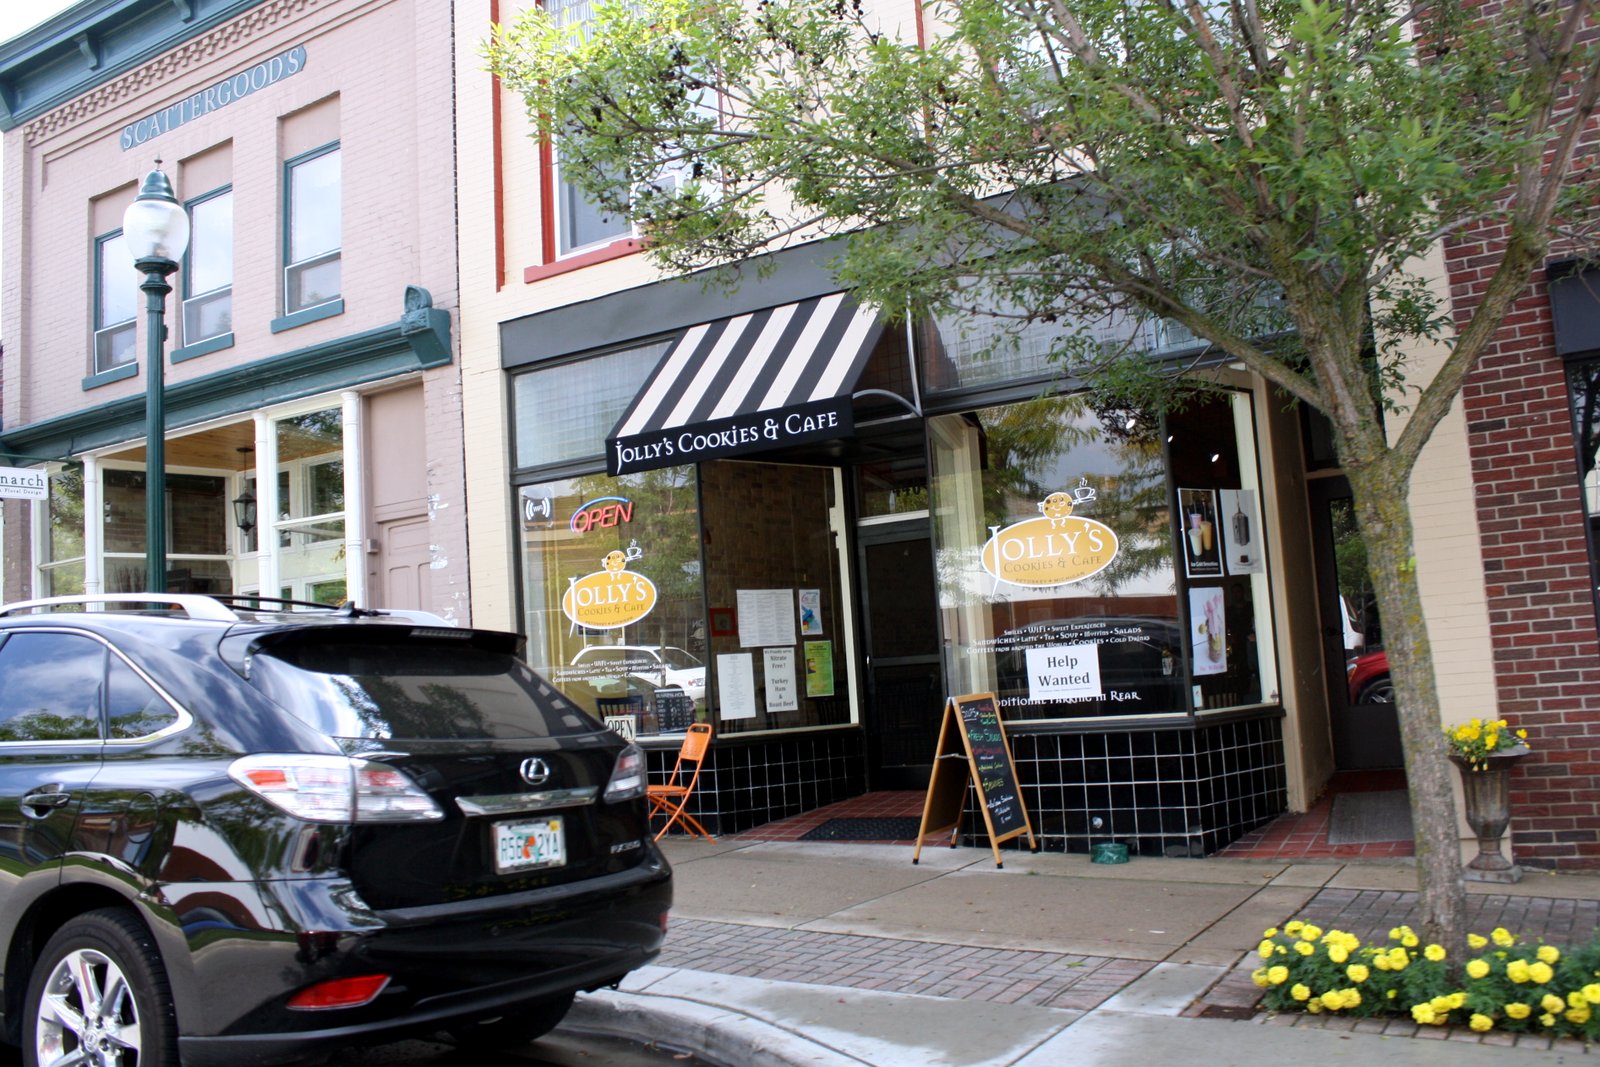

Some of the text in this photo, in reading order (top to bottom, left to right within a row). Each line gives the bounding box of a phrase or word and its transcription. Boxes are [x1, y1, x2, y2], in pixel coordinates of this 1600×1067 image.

[122, 47, 300, 150] SCATTERGOOD'S
[763, 418, 780, 440] &
[572, 502, 633, 533] OPEN
[1047, 655, 1079, 670] Help
[1038, 672, 1091, 687] Wanted
[1111, 690, 1142, 702] REAR
[607, 719, 633, 740] OPEN
